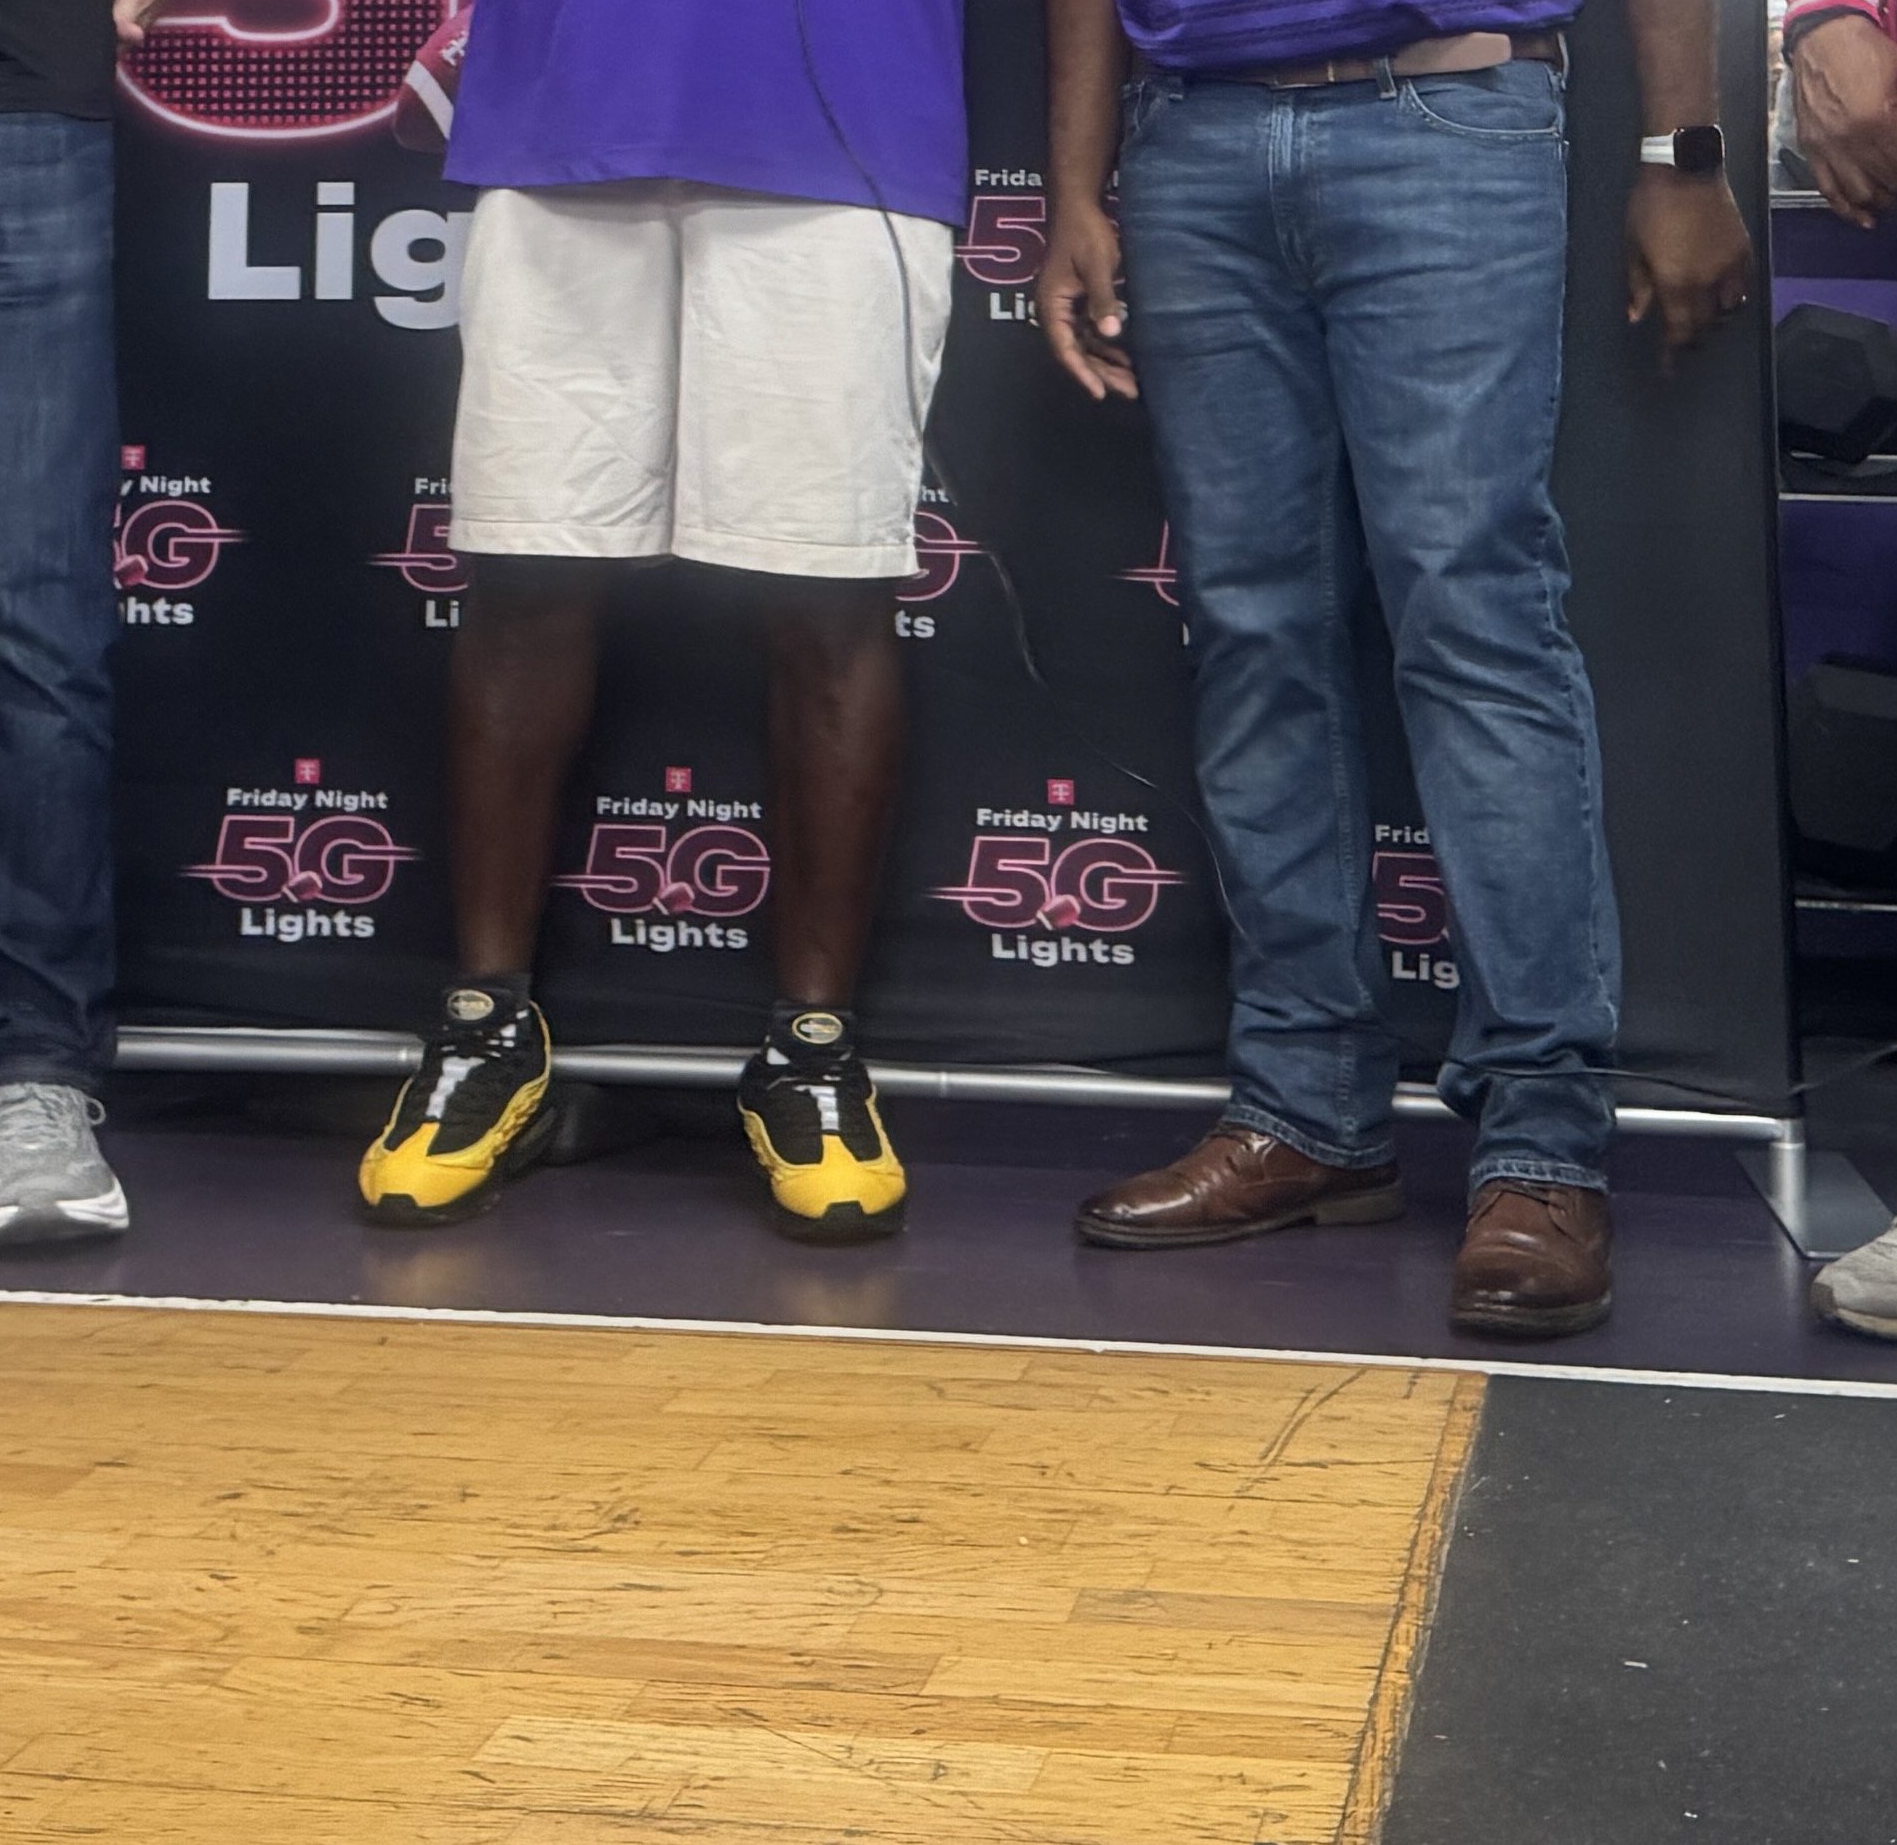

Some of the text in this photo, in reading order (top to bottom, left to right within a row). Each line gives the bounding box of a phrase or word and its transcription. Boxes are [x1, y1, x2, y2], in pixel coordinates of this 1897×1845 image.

[974, 169, 1043, 187] Frida
[208, 180, 474, 330] Lig
[140, 475, 212, 496] Night
[117, 500, 225, 590] G
[226, 788, 389, 812] Friday Night
[597, 796, 761, 822] Friday Night
[976, 809, 1148, 834] Friday Night
[206, 815, 401, 904] 5G
[575, 823, 771, 917] 5G
[956, 836, 1166, 932] 5G
[240, 907, 375, 942] Lights
[611, 918, 748, 953] Lights
[991, 934, 1134, 967] Lights
[1391, 950, 1460, 990] Lig
